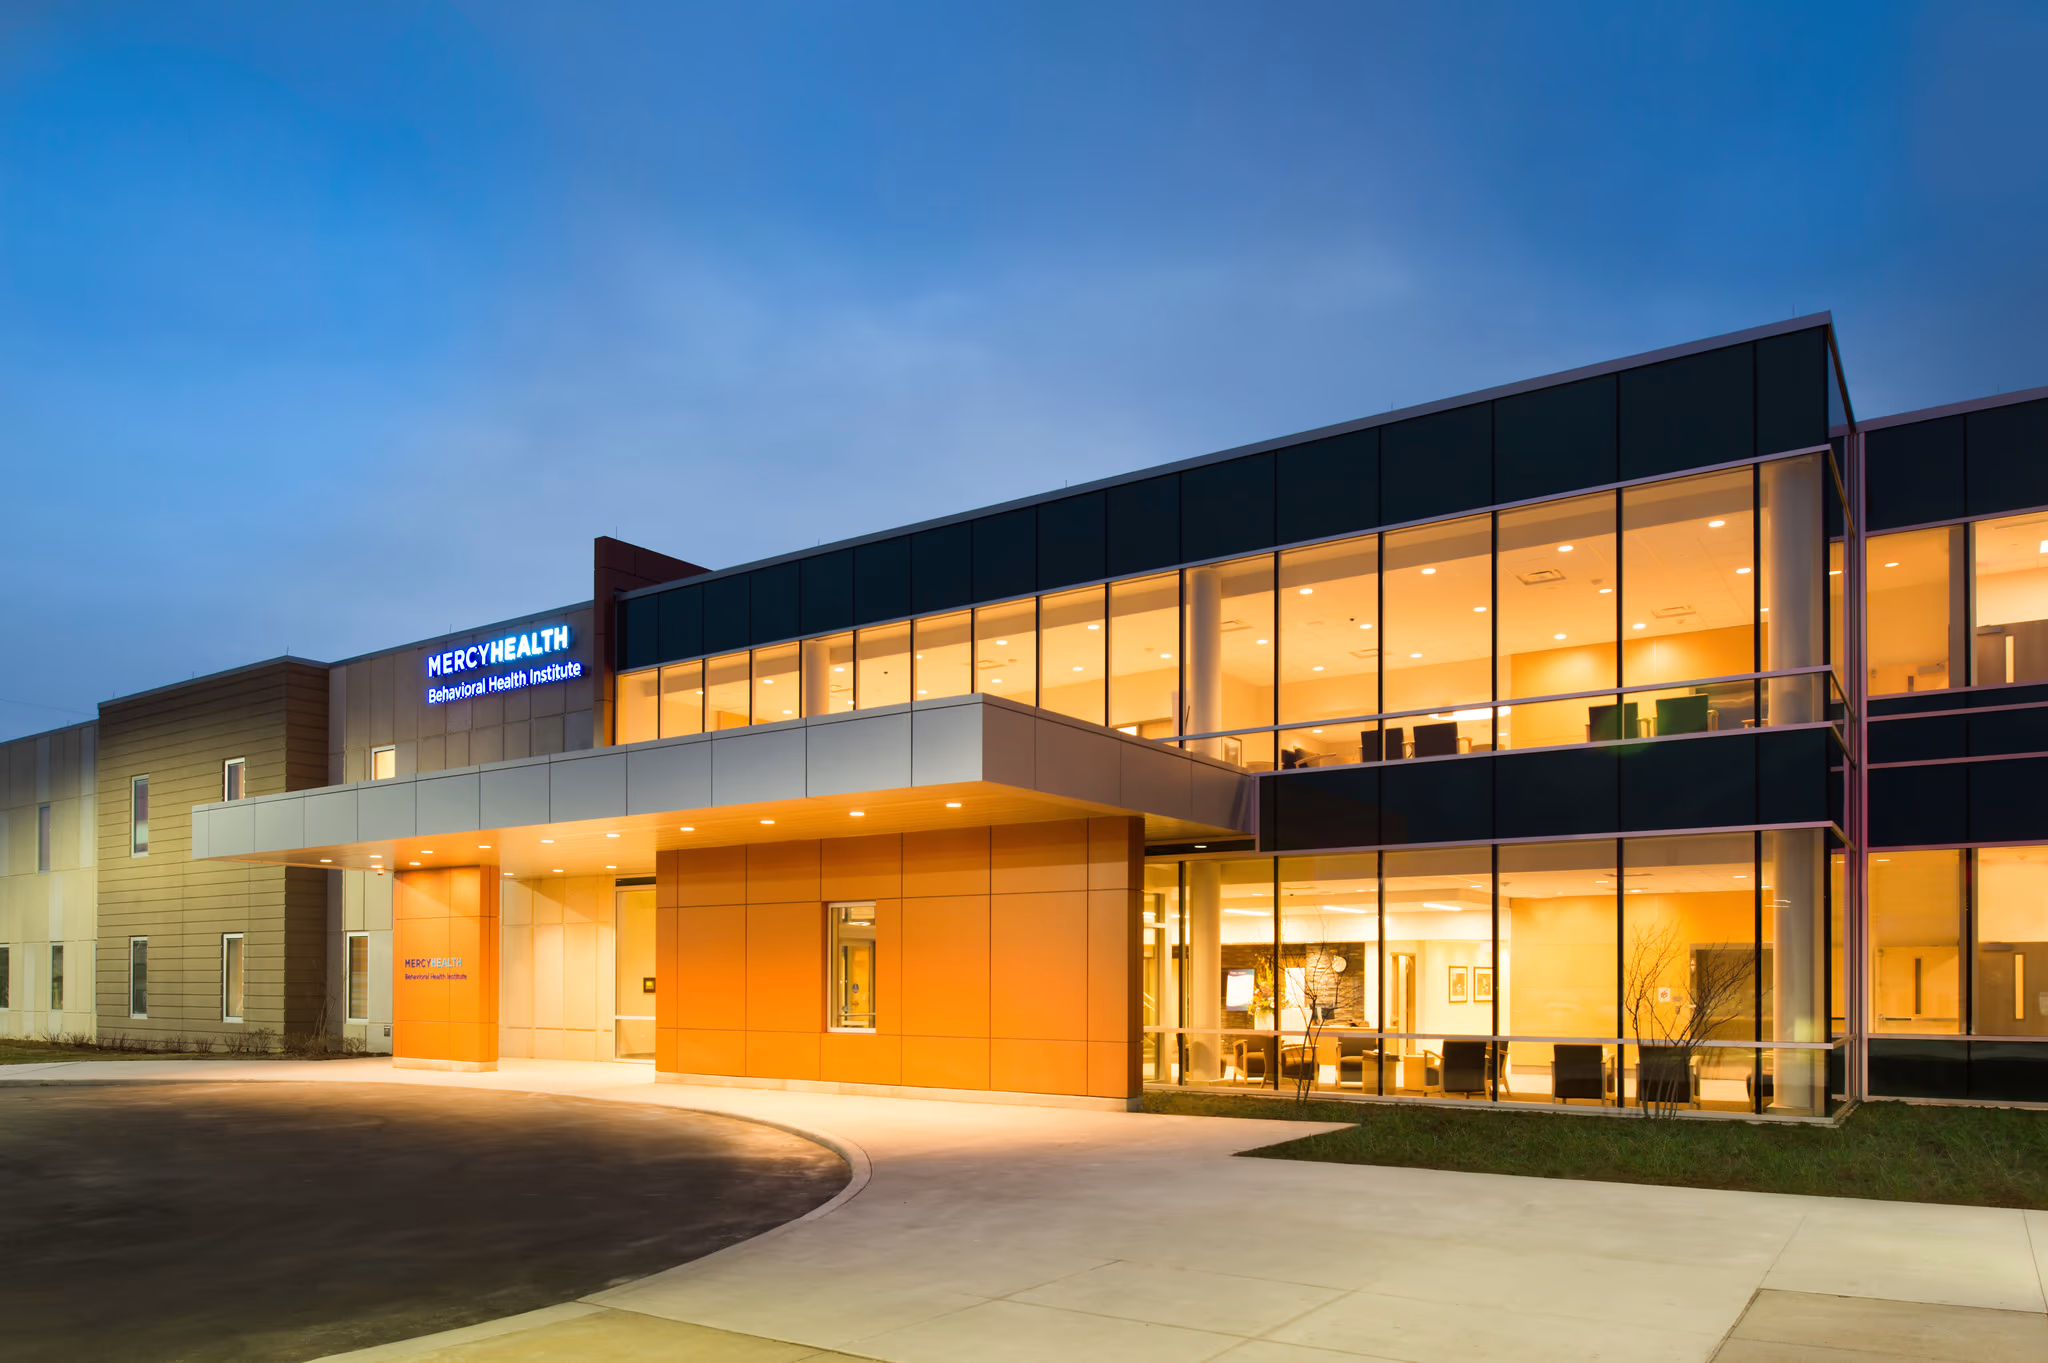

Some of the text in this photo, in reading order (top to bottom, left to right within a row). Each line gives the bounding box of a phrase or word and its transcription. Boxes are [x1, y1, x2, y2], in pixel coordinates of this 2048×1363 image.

[428, 625, 569, 678] MERCYHEALTH
[428, 661, 582, 704] Behavioral Health Institute
[404, 957, 463, 968] MERCYHEALTH
